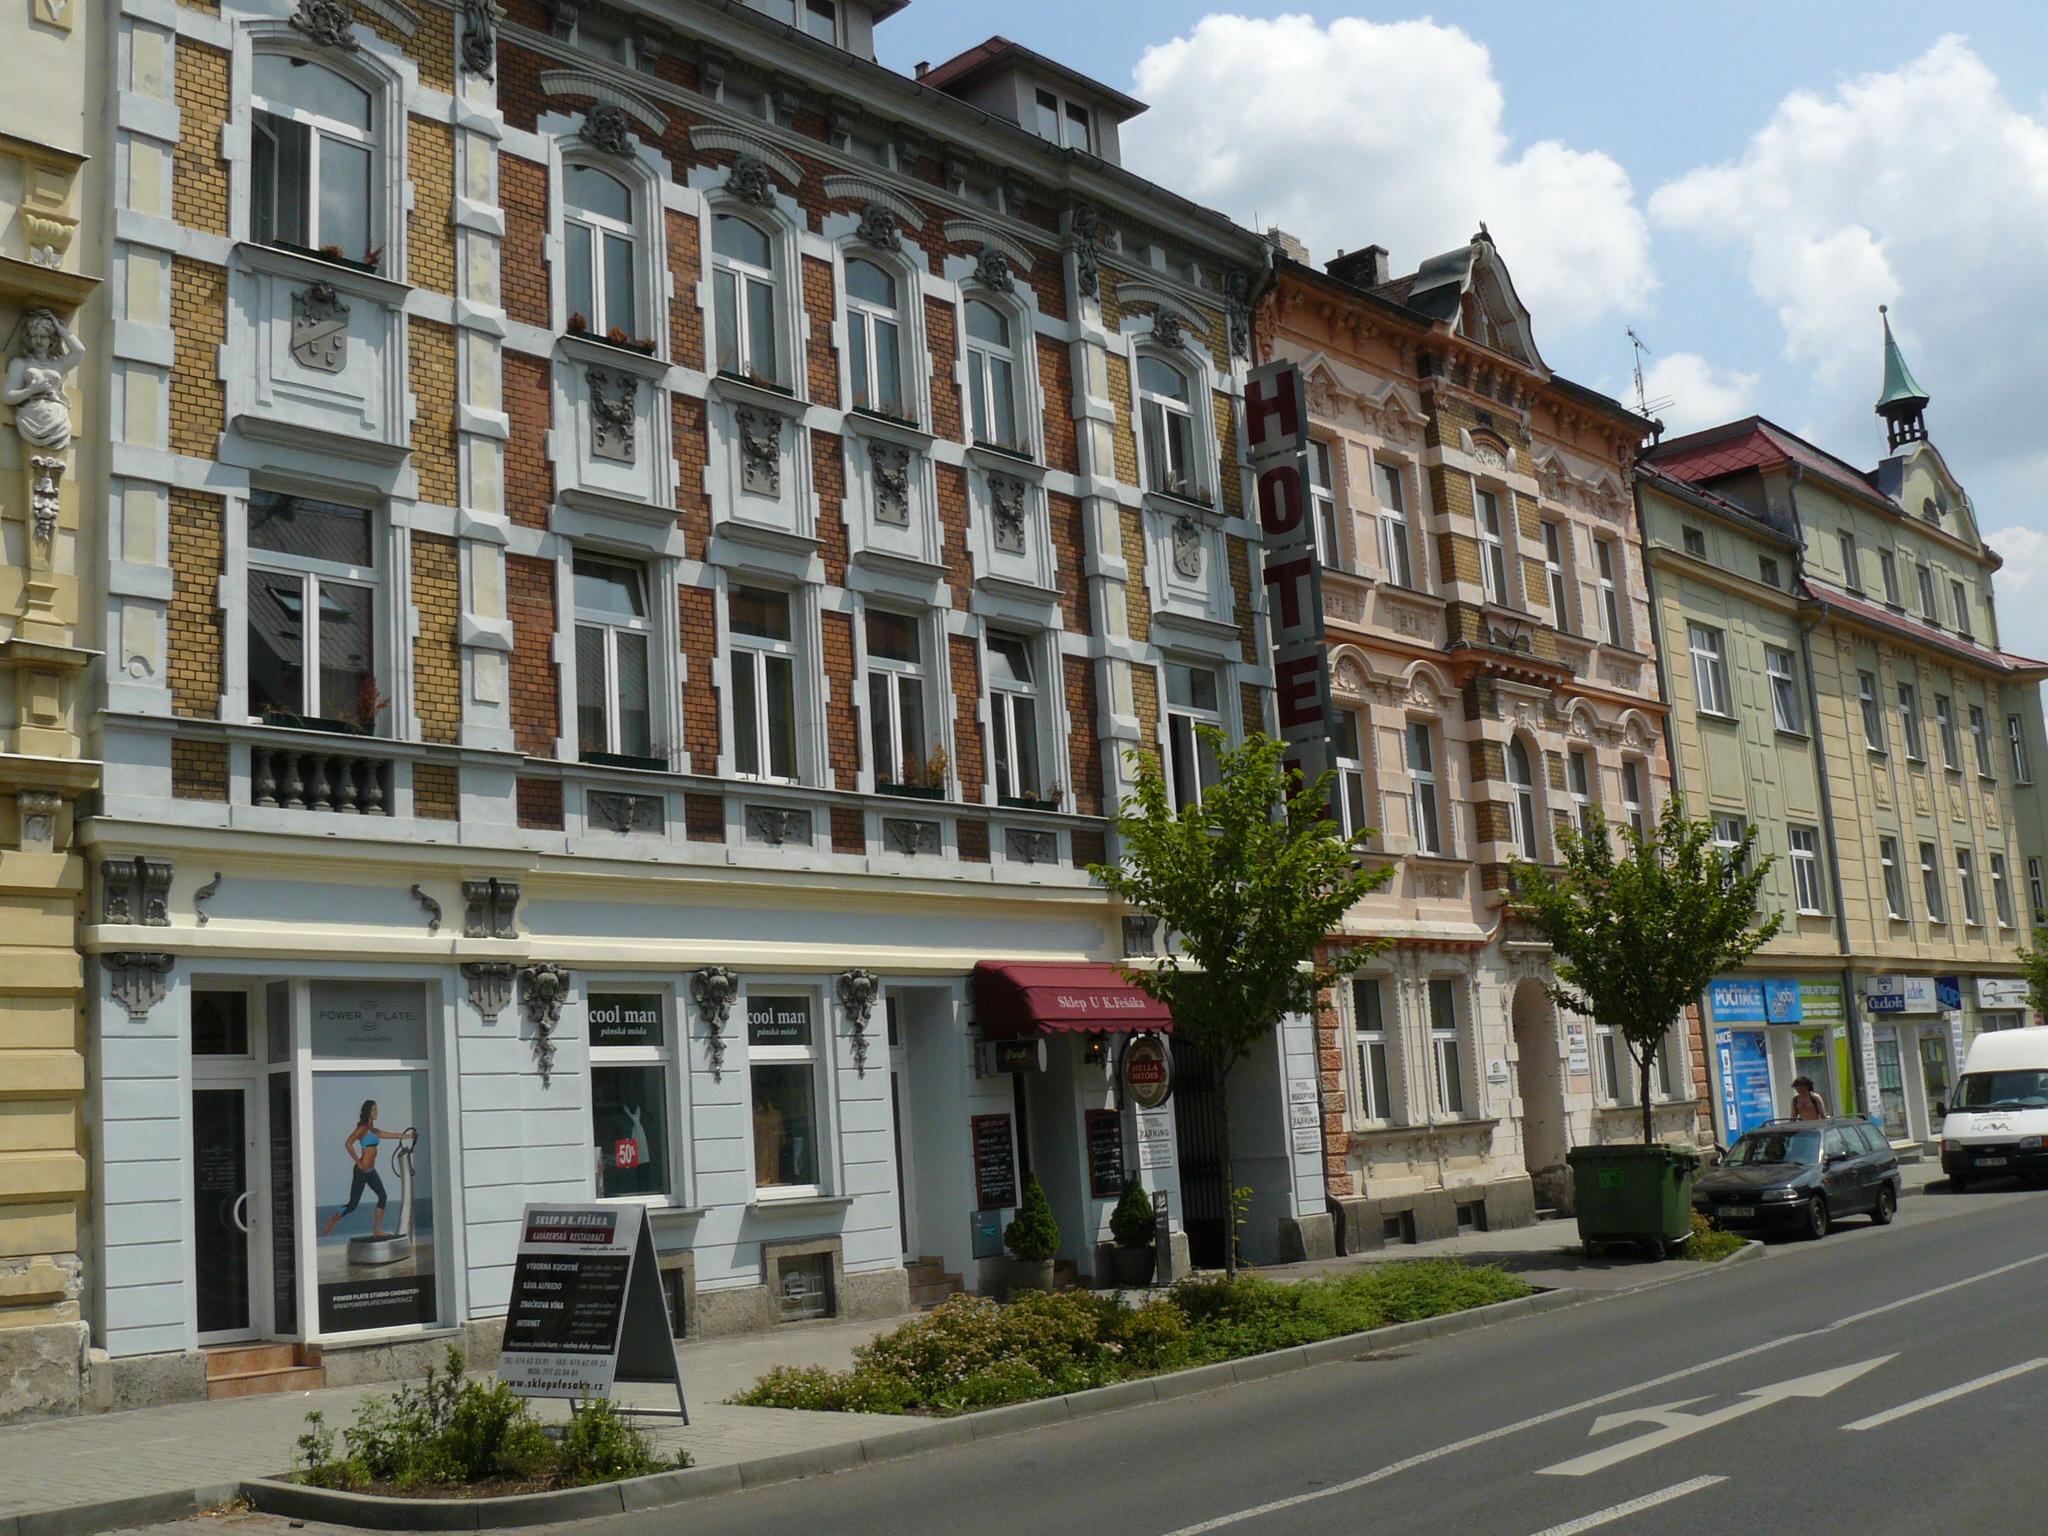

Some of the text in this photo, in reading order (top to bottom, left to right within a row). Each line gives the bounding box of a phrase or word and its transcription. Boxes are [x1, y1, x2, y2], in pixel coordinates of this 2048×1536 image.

[1244, 368, 1331, 824] HOTEL
[1715, 984, 1760, 1006] POČÍTAČE
[1057, 995, 1087, 1012] Sklep
[1089, 996, 1099, 1008] U
[319, 1010, 414, 1021] POWER PLATE
[589, 1005, 657, 1023] cool man
[747, 1007, 806, 1024] cool man
[600, 1027, 626, 1038] pánská
[1132, 1063, 1159, 1072] STELLA
[1132, 1071, 1159, 1080] ARTOIS
[1292, 1116, 1318, 1127] PARKING
[1139, 1128, 1170, 1138] PARKING
[535, 1215, 559, 1225] SKLEP
[560, 1215, 566, 1225] U
[577, 1214, 608, 1226] FEŠÁKA
[569, 1232, 605, 1242] RESTAURACE
[538, 1281, 562, 1290] ALFREDO
[332, 1294, 353, 1302] POWER
[369, 1290, 390, 1299] STUDIO
[516, 1319, 541, 1327] INTERNET
[503, 1378, 604, 1391] ww.sklepufesak.cz
